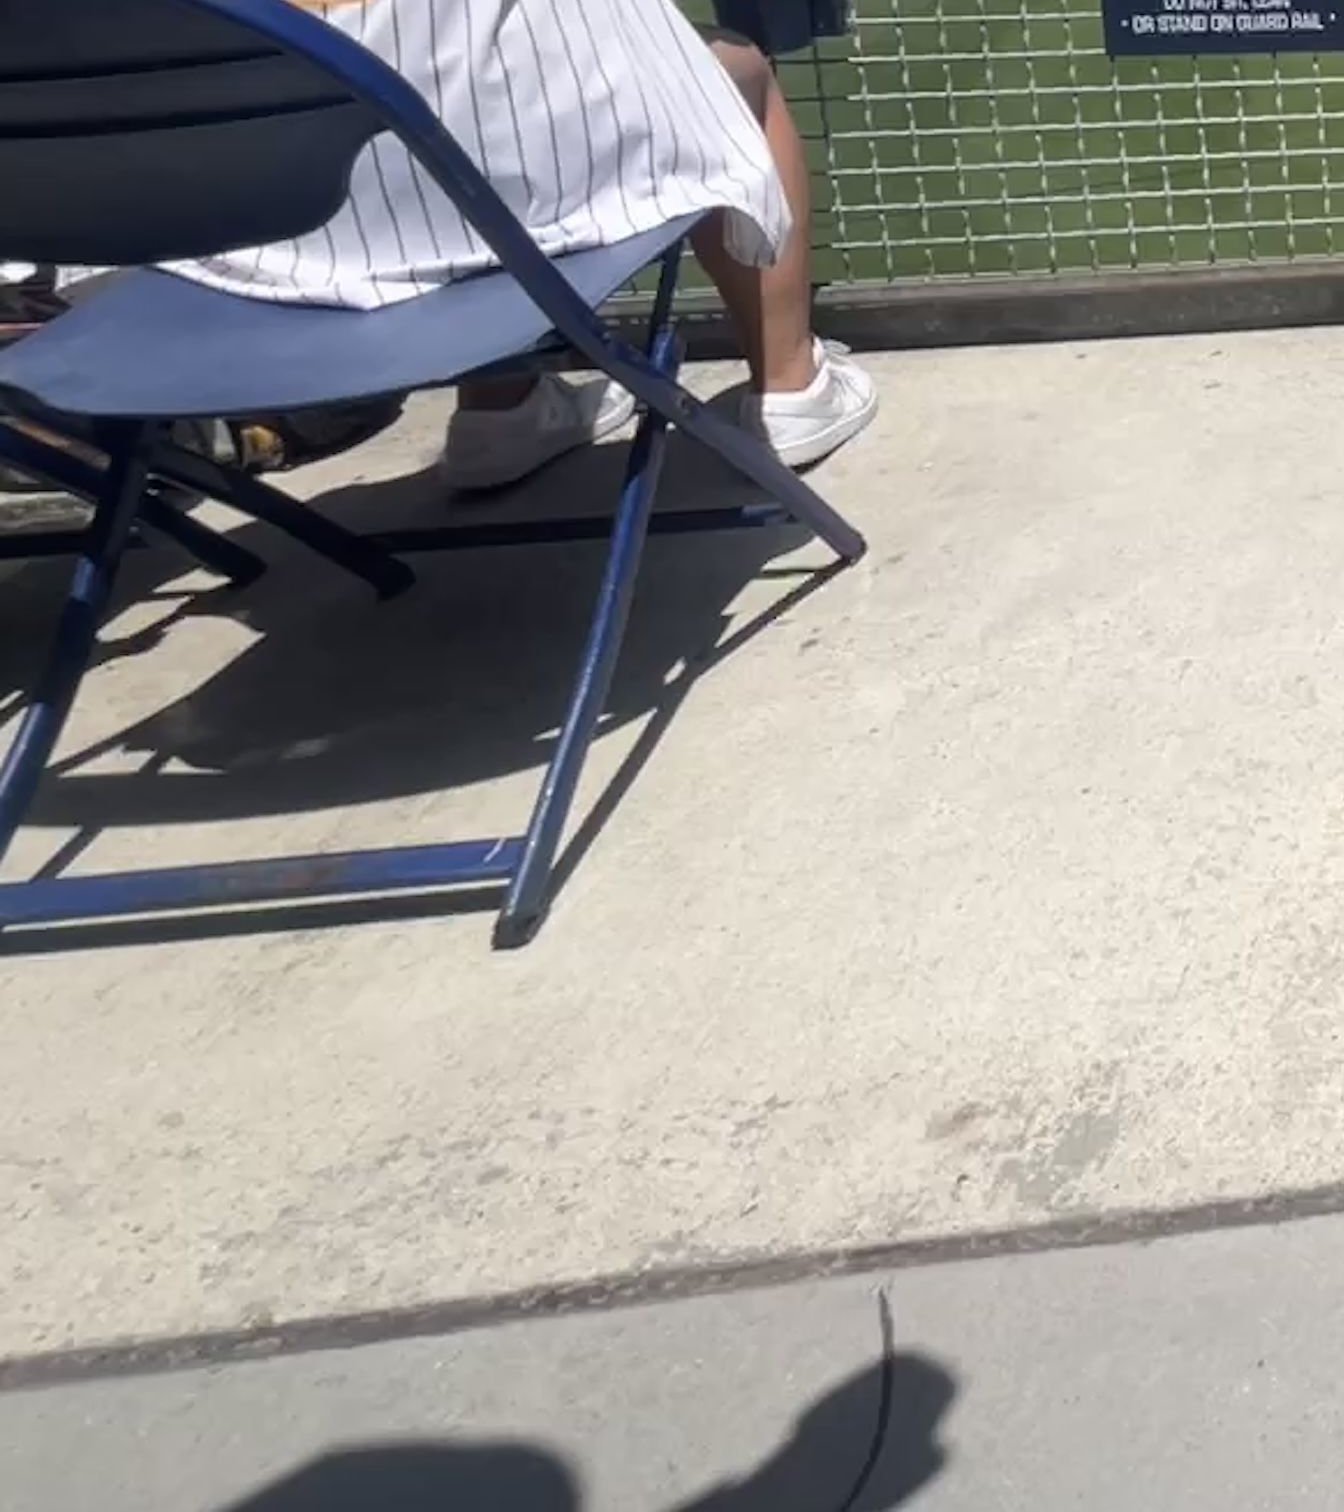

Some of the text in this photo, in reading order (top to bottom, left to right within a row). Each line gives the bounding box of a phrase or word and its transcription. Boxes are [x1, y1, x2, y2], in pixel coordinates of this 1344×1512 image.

[1132, 11, 1324, 34] OR STAND ON GUARD RAIL
